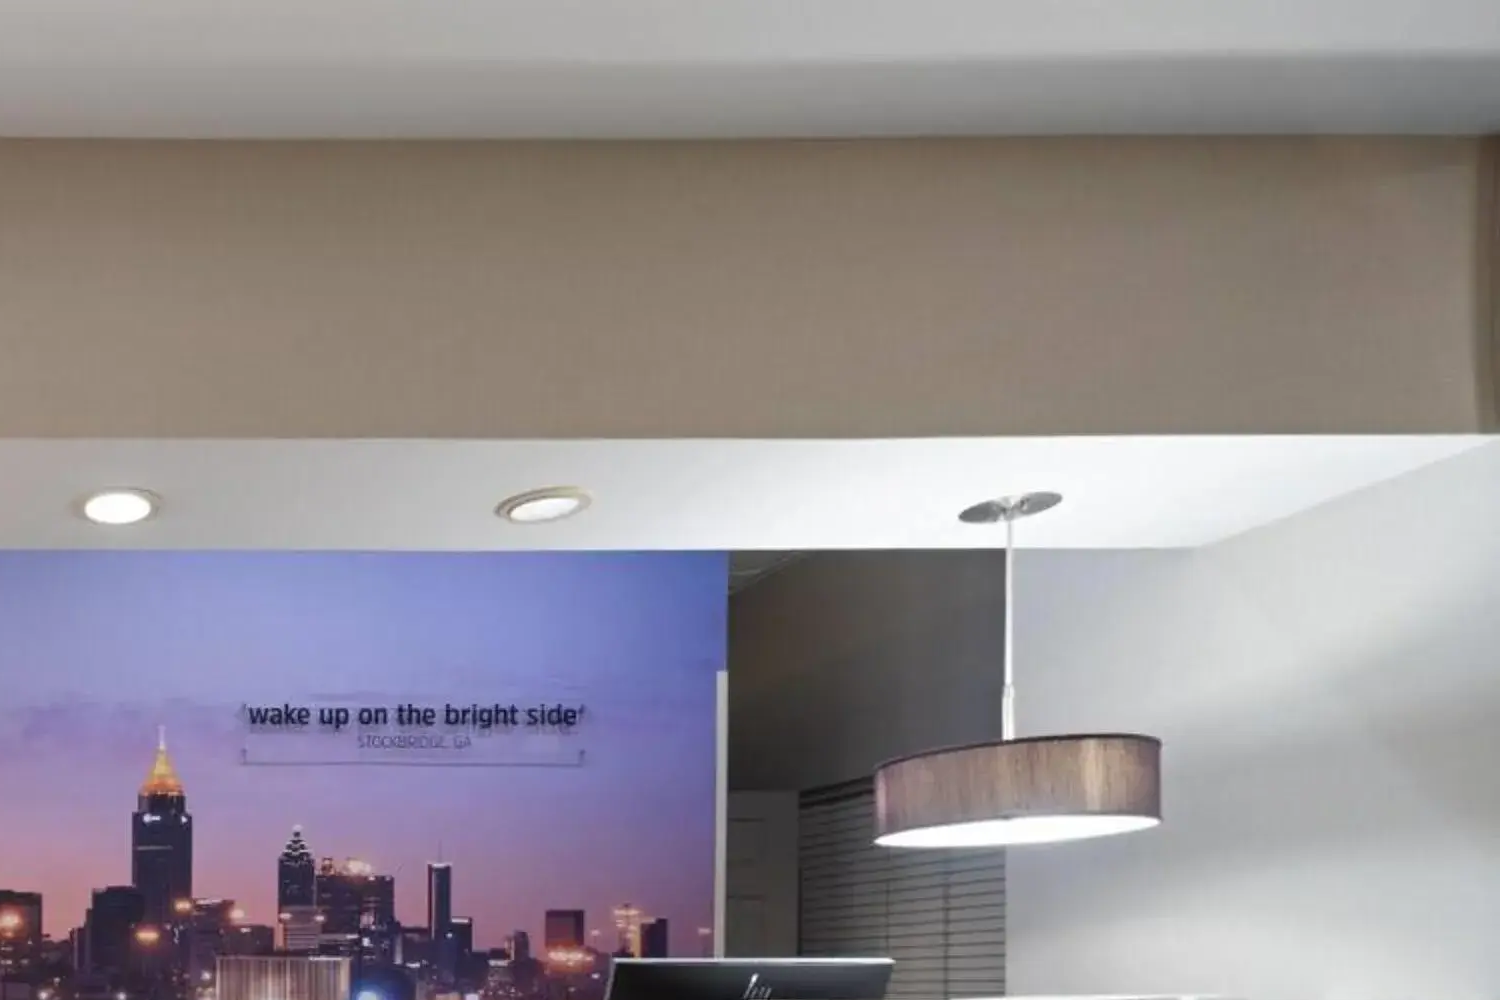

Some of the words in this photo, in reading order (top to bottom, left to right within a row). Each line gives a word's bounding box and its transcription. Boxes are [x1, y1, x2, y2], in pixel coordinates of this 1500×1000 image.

[248, 704, 310, 726] wake
[318, 708, 349, 729] up
[358, 708, 388, 726] on
[396, 704, 436, 726] the
[444, 703, 518, 729] bright
[526, 703, 577, 726] side
